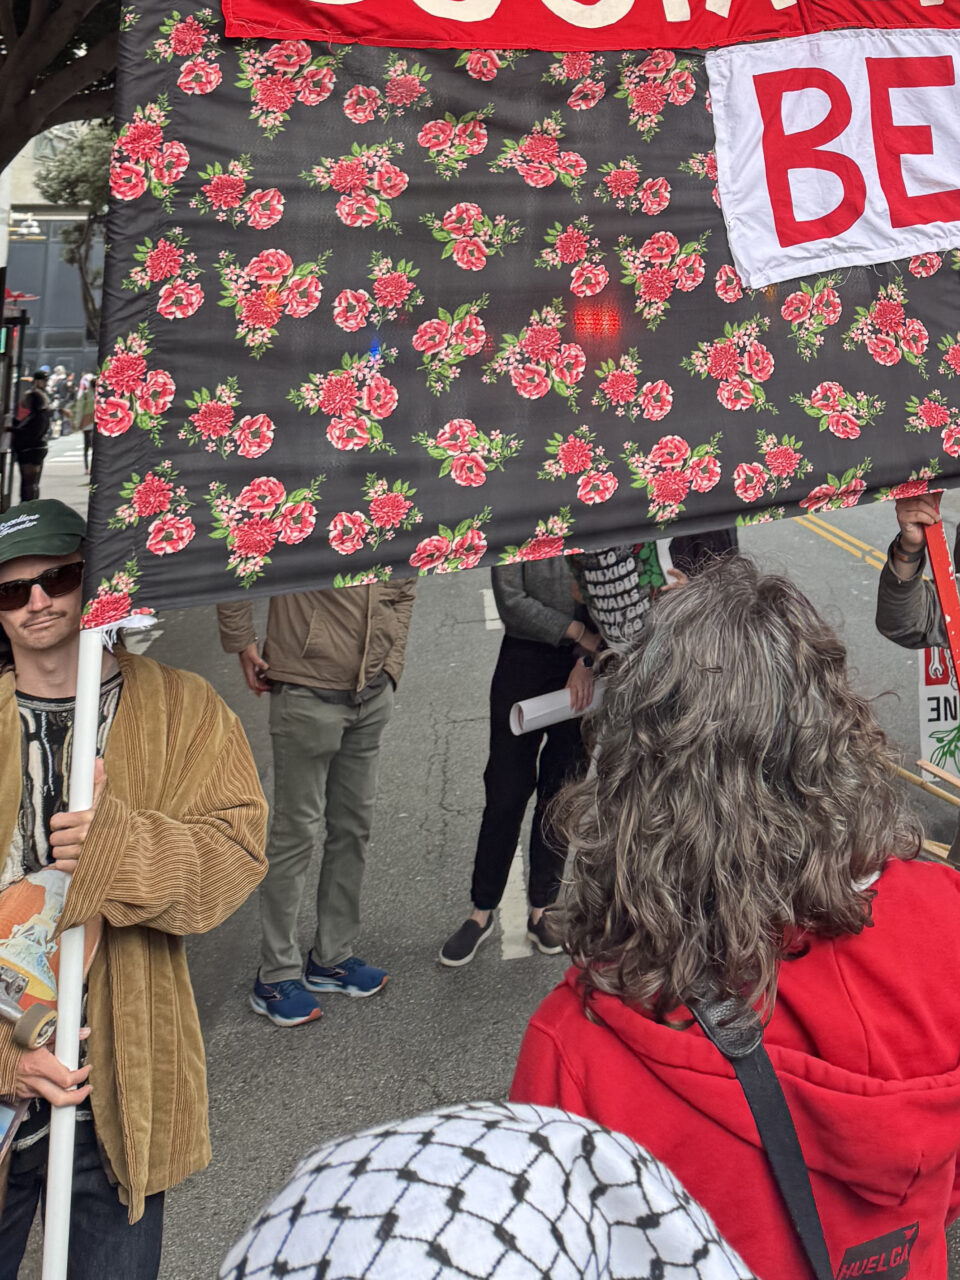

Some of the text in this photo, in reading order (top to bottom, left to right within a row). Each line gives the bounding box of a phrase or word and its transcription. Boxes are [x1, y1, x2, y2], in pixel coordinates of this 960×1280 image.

[584, 557, 636, 582] MEXICO
[598, 551, 617, 567] TO
[587, 572, 639, 596] BORDER
[594, 589, 640, 610] WALLS
[626, 597, 650, 620] GOT
[837, 1242, 909, 1280] HUELGA
